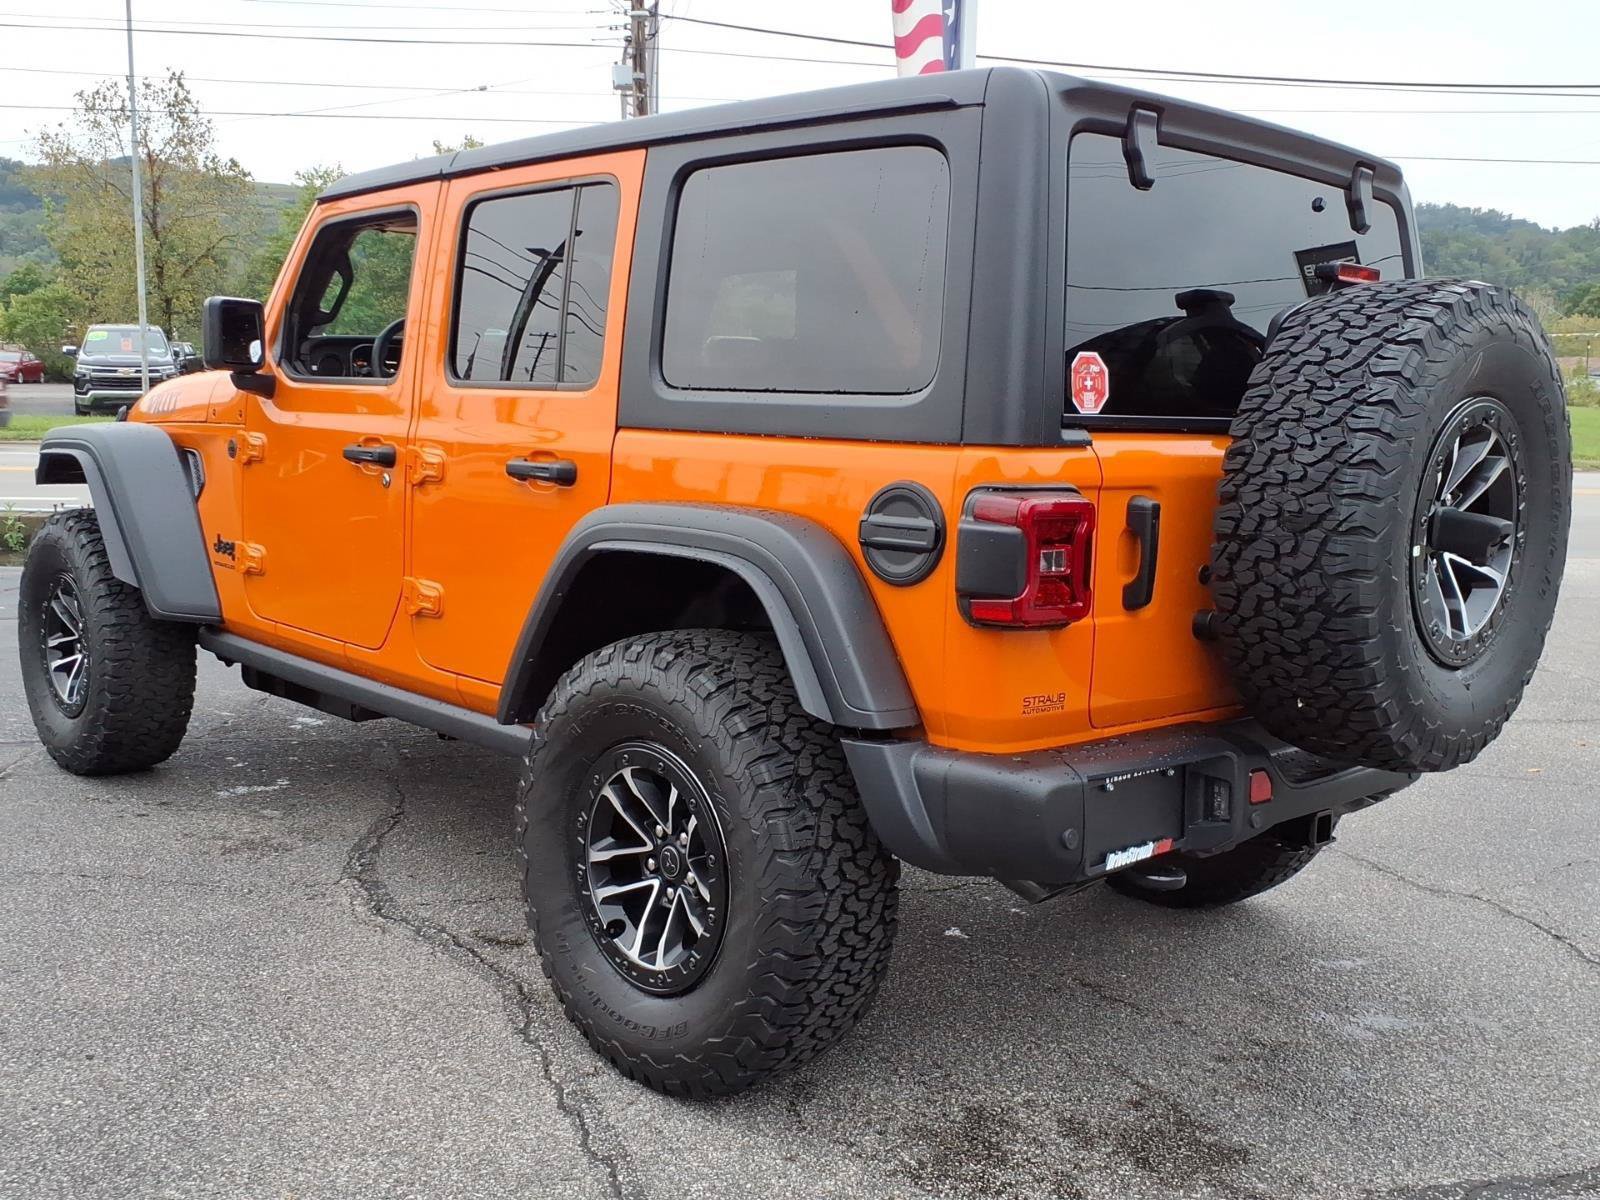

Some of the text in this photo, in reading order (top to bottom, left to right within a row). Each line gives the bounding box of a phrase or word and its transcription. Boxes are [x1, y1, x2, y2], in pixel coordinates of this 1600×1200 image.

[213, 533, 236, 562] Jeep
[1022, 692, 1066, 707] STRAUB
[1022, 704, 1065, 715] AUTOMOTIVE
